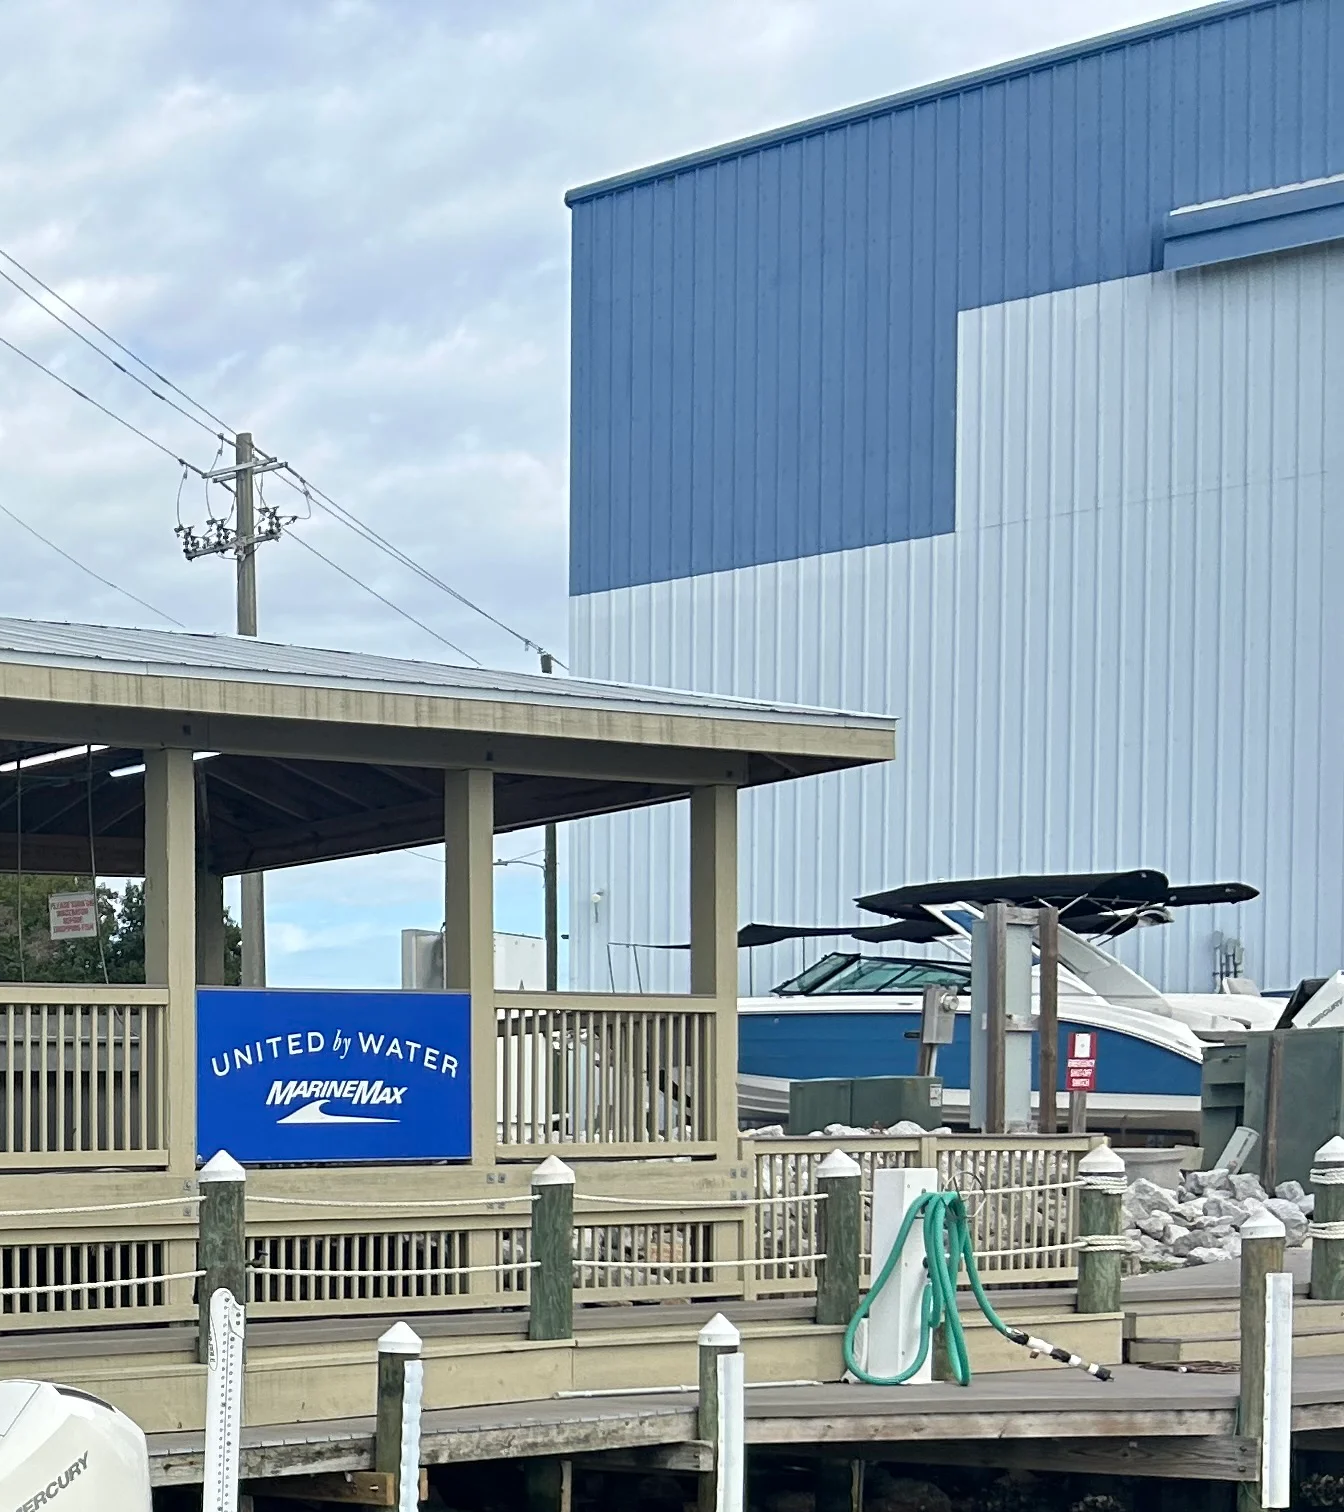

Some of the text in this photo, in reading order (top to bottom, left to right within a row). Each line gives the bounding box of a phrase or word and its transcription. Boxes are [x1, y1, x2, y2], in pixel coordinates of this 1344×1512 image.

[211, 1029, 459, 1079] UNITED by WATER
